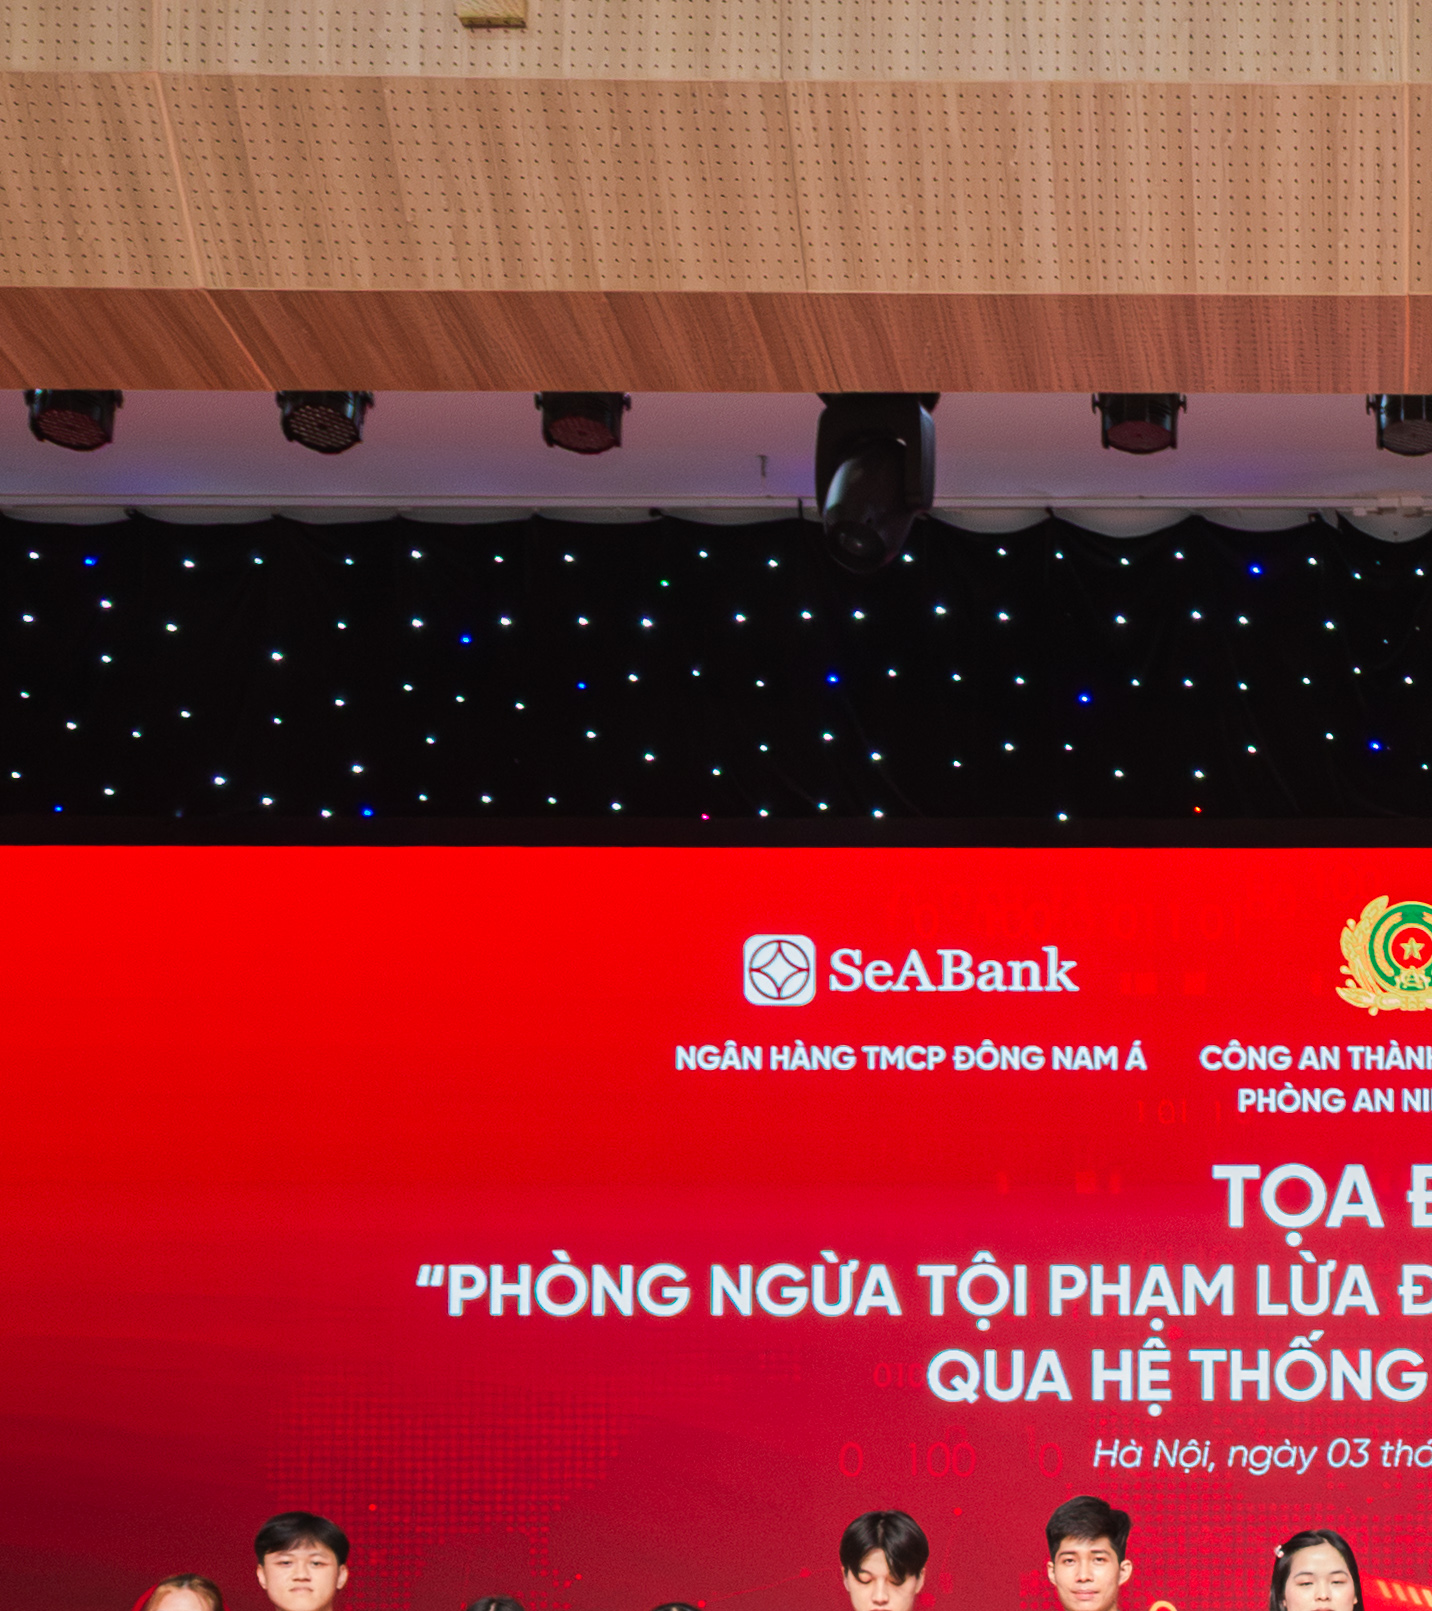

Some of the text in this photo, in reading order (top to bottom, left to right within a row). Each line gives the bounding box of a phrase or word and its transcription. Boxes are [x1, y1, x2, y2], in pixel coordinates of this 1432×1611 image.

[829, 946, 1079, 992] SeABank
[676, 1039, 1147, 1070] NGÂN HÀNG TMCP ĐÔNG NAM Á
[1199, 1039, 1292, 1070] CÔNG
[1298, 1046, 1340, 1070] AN
[1238, 1082, 1346, 1113] PHÒNG
[1353, 1088, 1394, 1112] AN
[1212, 1163, 1384, 1247] TỌA
[416, 1250, 690, 1317] “PHÒNG
[710, 1250, 902, 1317] NGỪA
[917, 1250, 1027, 1331] TỘI
[1049, 1264, 1234, 1331] PHẠM
[1257, 1250, 1380, 1316] LỪA
[927, 1349, 1072, 1403] QUA
[1092, 1337, 1172, 1416] HỆ
[1189, 1330, 1428, 1402] THỐNG
[1093, 1439, 1143, 1468] Hà
[1153, 1439, 1215, 1473] Nội,
[1228, 1439, 1317, 1475] ngày
[1327, 1438, 1371, 1468] 03
